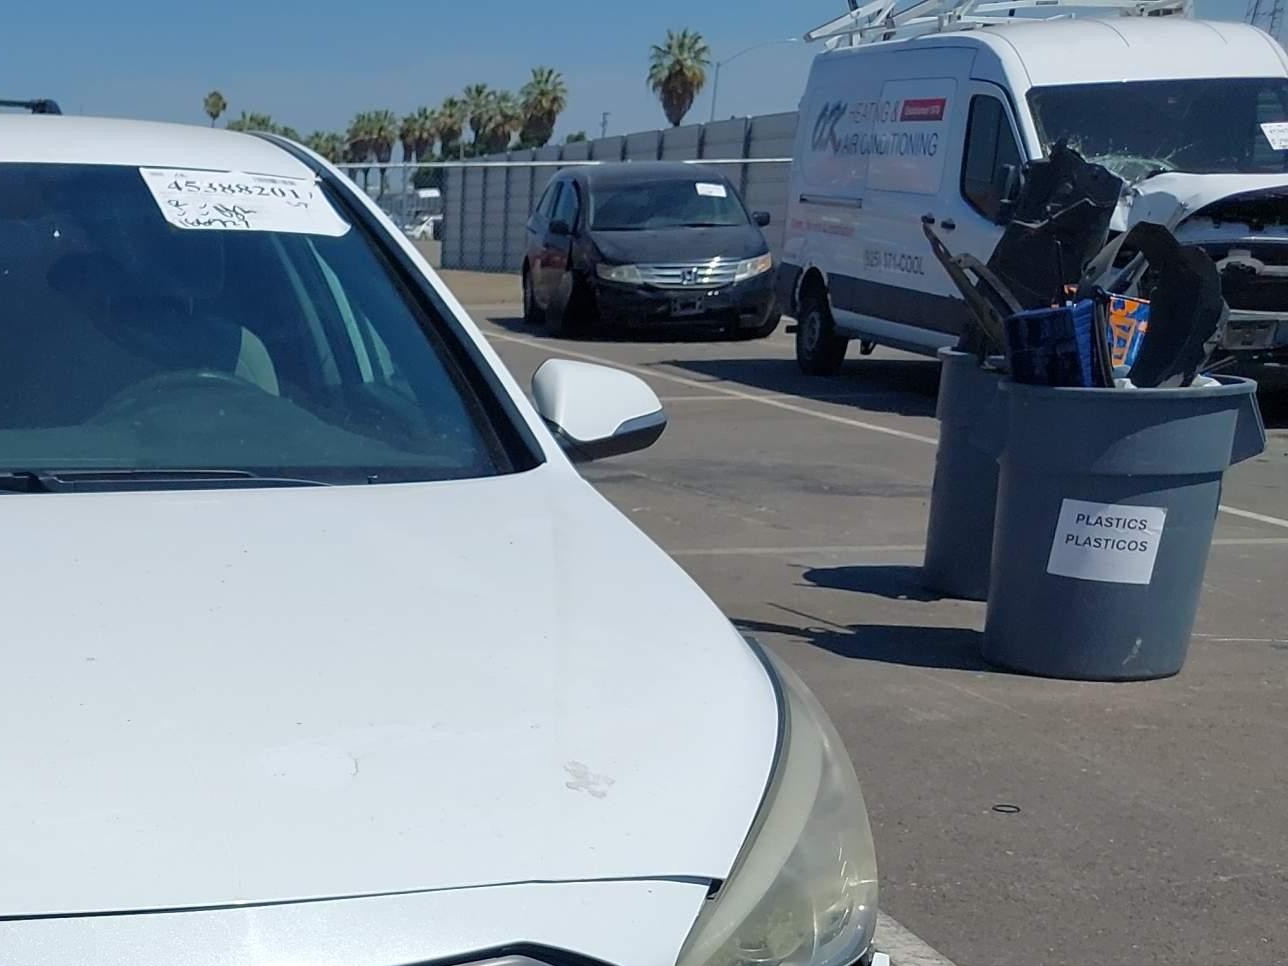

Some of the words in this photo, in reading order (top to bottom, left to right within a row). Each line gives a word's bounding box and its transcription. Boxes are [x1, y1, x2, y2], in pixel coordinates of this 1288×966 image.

[860, 132, 938, 156] CONDITIONING
[167, 180, 300, 199] 45388201
[1075, 513, 1148, 530] PLASTICS
[1065, 534, 1148, 552] PLASTICOS
